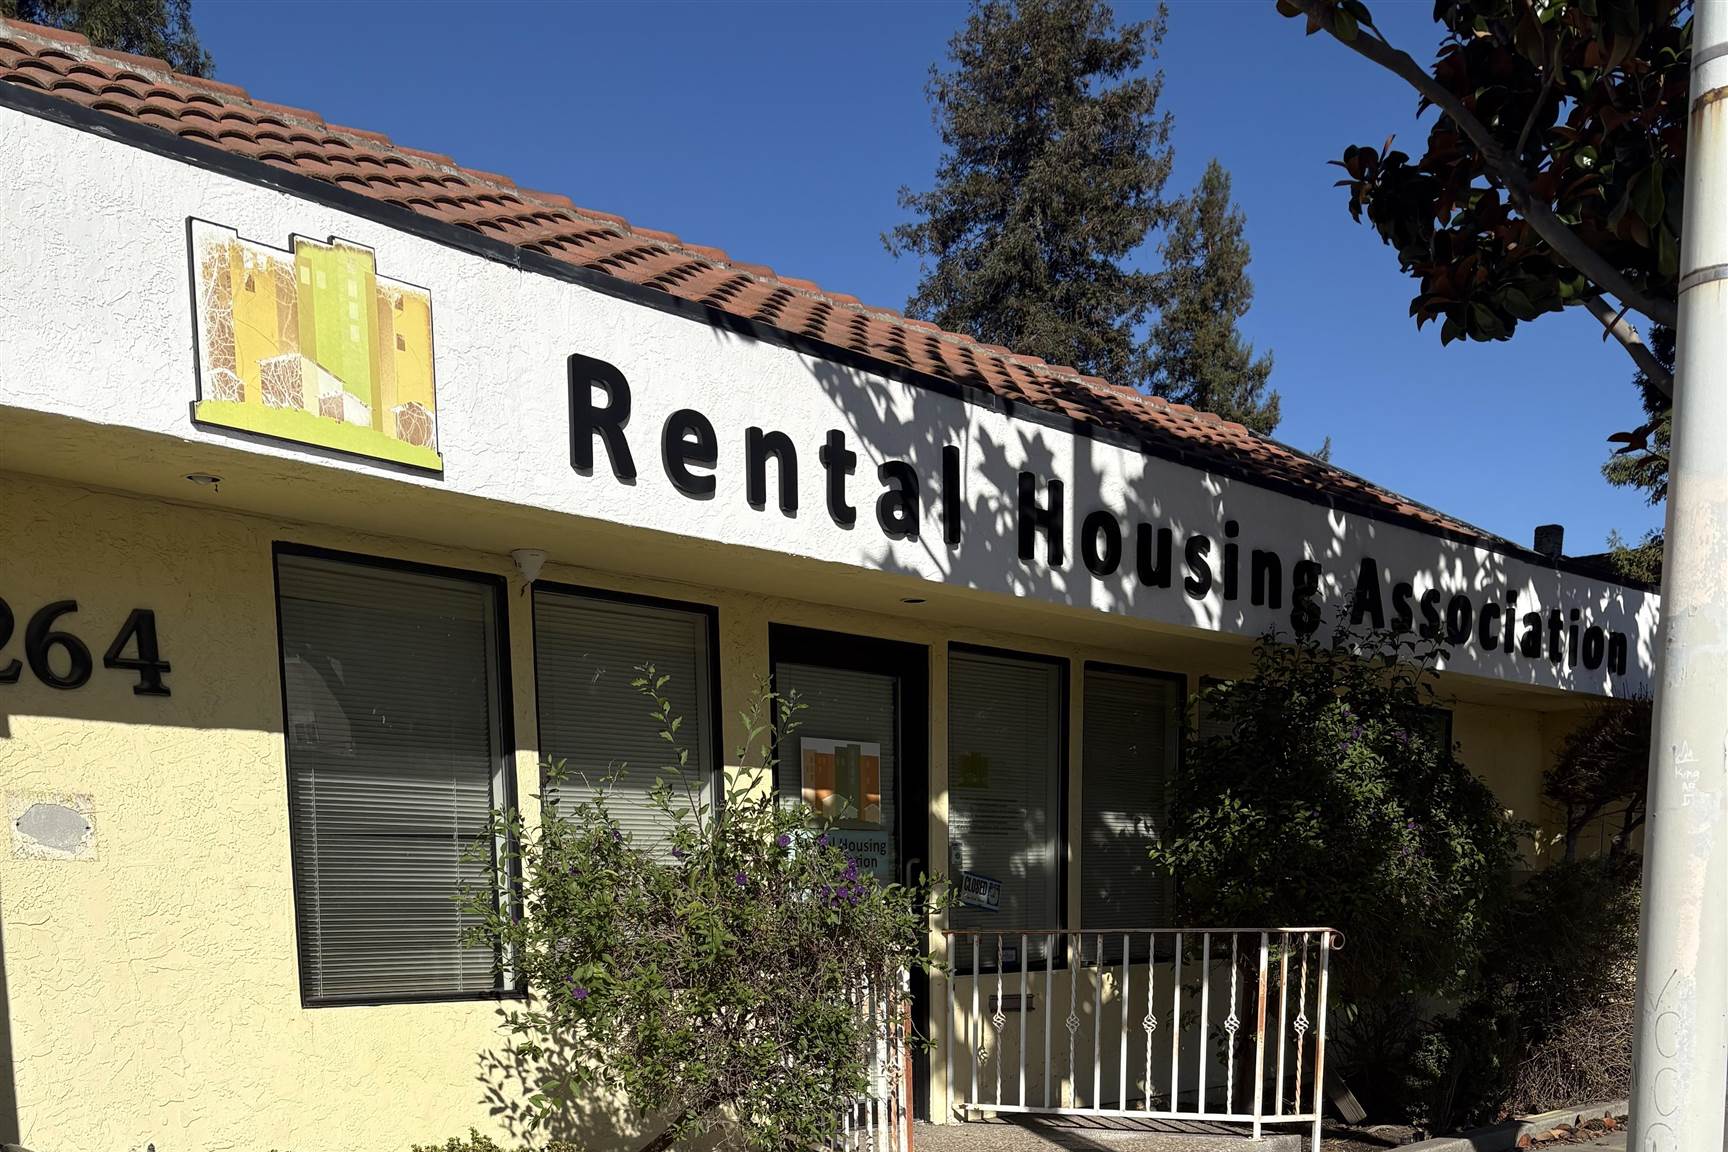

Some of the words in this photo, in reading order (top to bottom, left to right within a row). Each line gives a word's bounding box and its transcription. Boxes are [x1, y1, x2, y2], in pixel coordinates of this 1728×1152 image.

[567, 353, 961, 550] Rental
[1017, 471, 1322, 635] Housing
[1351, 558, 1628, 676] Association
[839, 837, 887, 856] Housing
[963, 875, 989, 897] CLOSED
